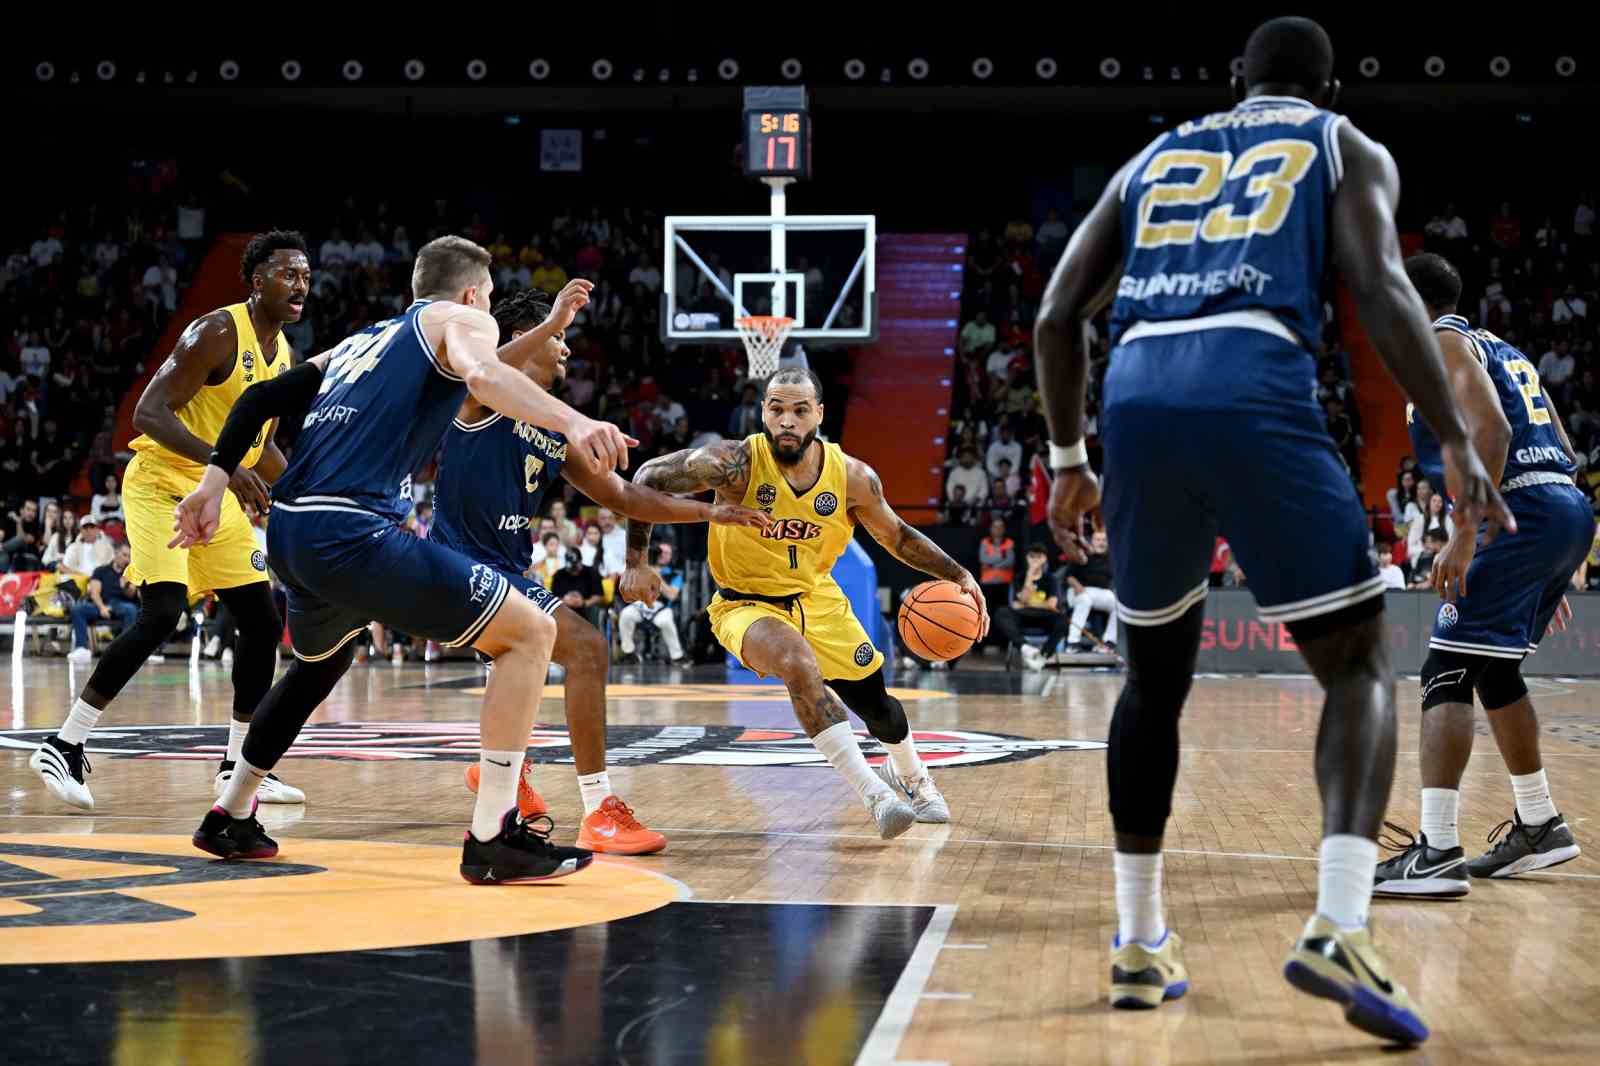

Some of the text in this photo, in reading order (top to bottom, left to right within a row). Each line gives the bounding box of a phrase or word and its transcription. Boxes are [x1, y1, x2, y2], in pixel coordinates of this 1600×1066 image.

[761, 113, 800, 133] 5:16
[767, 136, 796, 170] 17
[1135, 138, 1318, 248] 23
[1503, 359, 1551, 425] 2
[761, 519, 822, 540] MSK
[787, 544, 798, 569] 1
